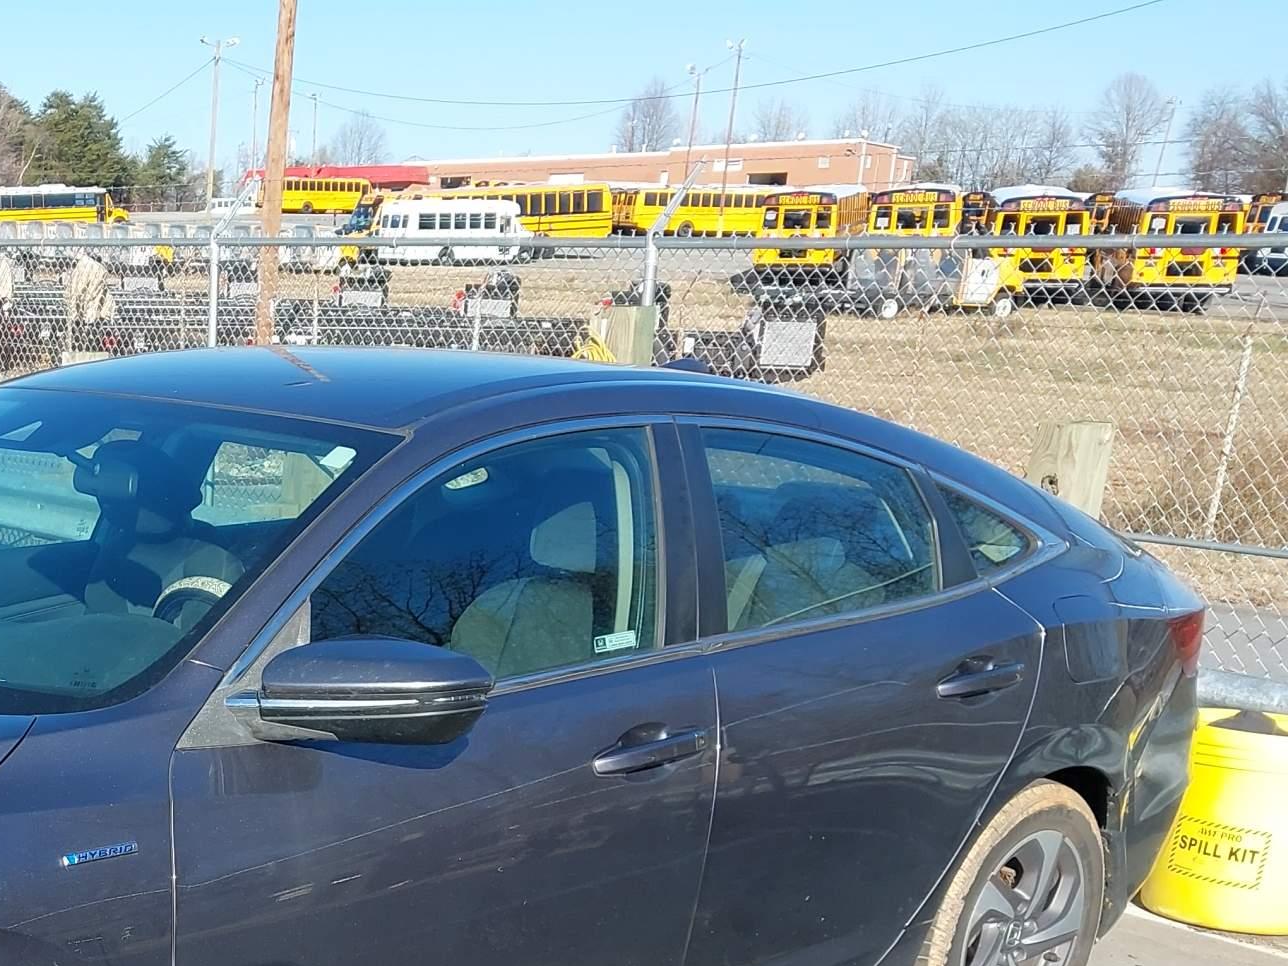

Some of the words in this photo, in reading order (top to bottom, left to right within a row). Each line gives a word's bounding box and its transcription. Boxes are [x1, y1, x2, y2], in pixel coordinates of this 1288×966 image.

[78, 844, 135, 862] HYBRID
[1179, 834, 1222, 858] SPILL
[1227, 846, 1261, 864] KIT
